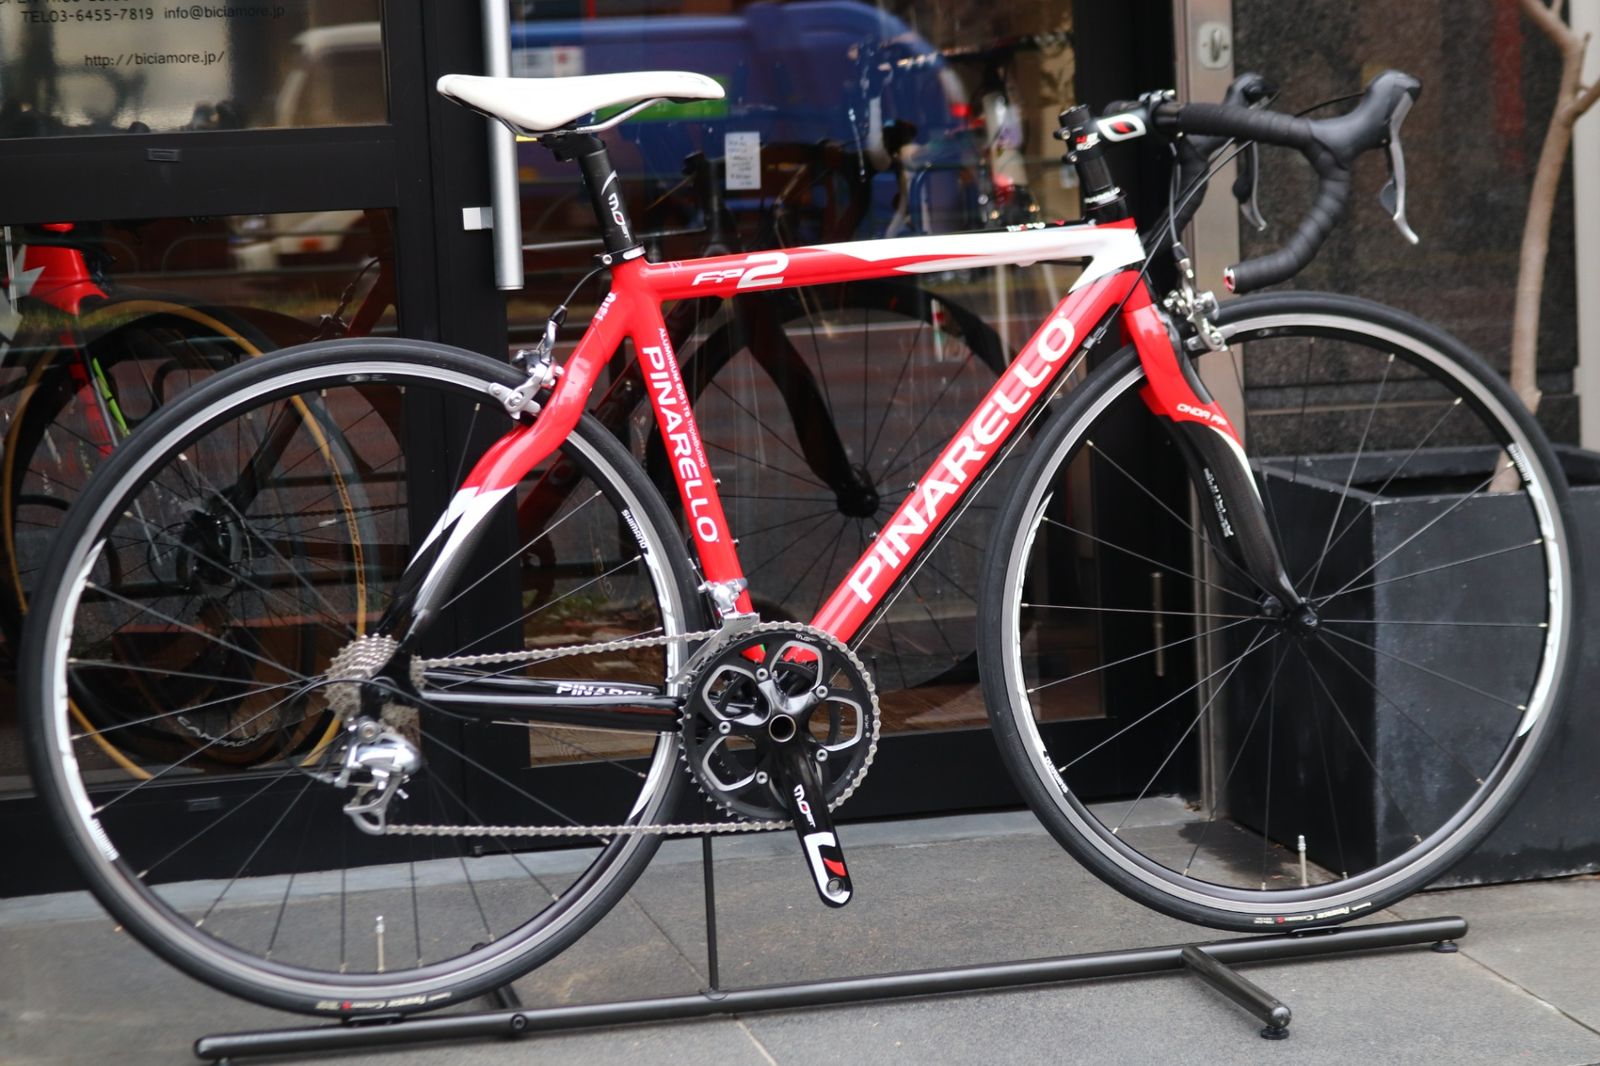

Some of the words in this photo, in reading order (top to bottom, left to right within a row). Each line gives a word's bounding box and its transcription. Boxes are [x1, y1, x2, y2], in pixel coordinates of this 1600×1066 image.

[84, 51, 225, 69] http://biciamore.jp/
[642, 346, 719, 543] PINARELLO
[847, 316, 1075, 604] PINARELLO
